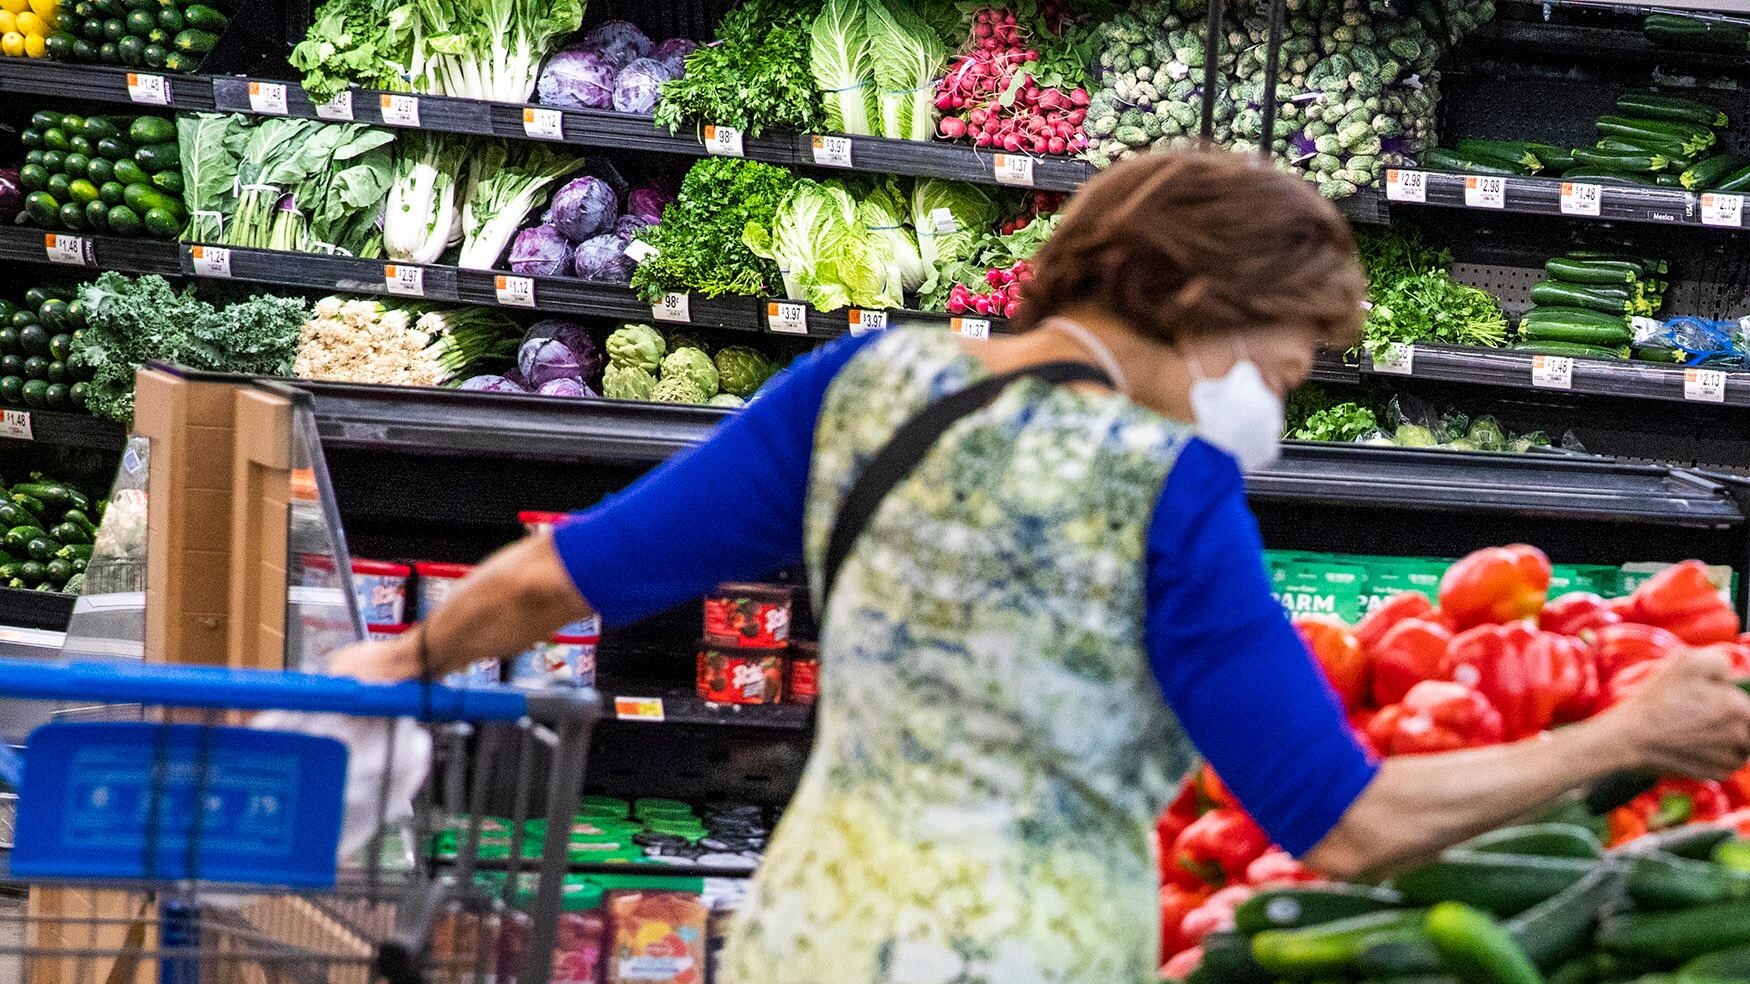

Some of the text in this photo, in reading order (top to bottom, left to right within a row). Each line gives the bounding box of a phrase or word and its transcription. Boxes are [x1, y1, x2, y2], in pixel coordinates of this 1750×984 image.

[827, 139, 845, 152] $3.97
[1402, 173, 1421, 187] $2.98
[1480, 178, 1500, 193] $2.98
[1576, 186, 1595, 201] $1.48
[1717, 197, 1736, 211] $2.13
[60, 239, 78, 253] $1.48
[207, 249, 224, 263] $1.24
[399, 269, 417, 282] $2.97
[510, 281, 528, 294] $1.12
[665, 295, 679, 308] 98¢
[782, 307, 800, 320] $3.97
[1548, 359, 1567, 373] $1.48
[1700, 373, 1720, 387] $2.13
[7, 412, 25, 427] $1.48
